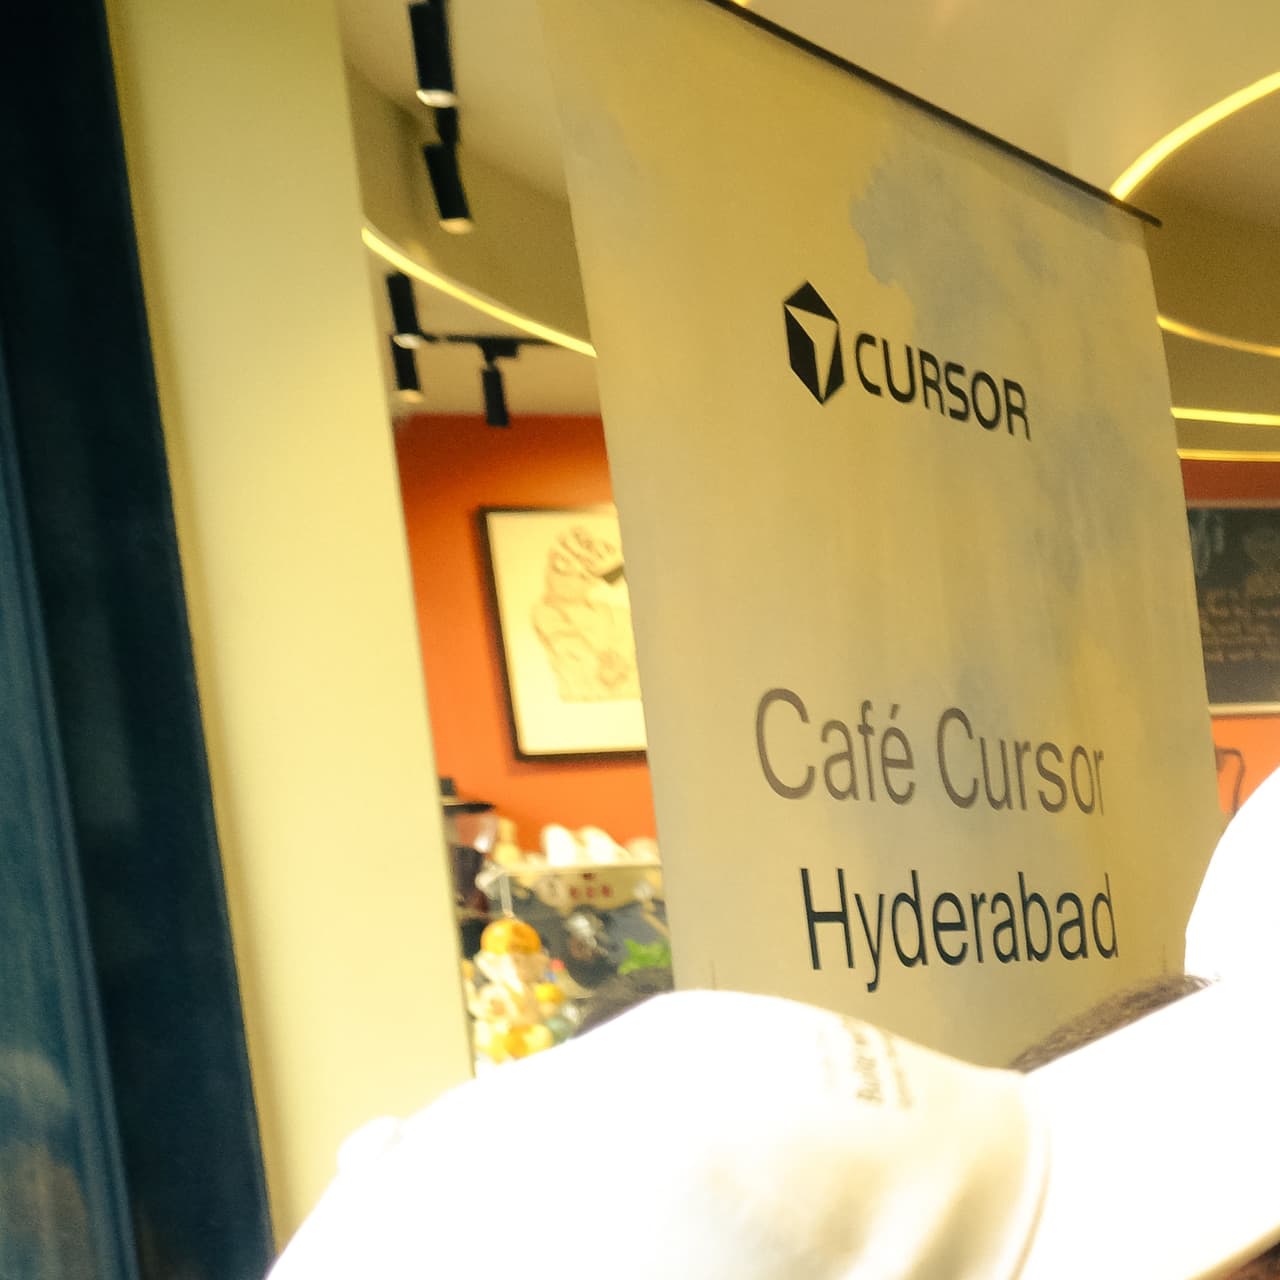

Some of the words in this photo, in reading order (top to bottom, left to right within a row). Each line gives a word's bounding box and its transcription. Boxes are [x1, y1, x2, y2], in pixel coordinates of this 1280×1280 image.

[855, 332, 1032, 441] CURSOR
[756, 688, 915, 806] Café
[937, 708, 1106, 816] Cursor
[800, 868, 1118, 993] Hyderabad
